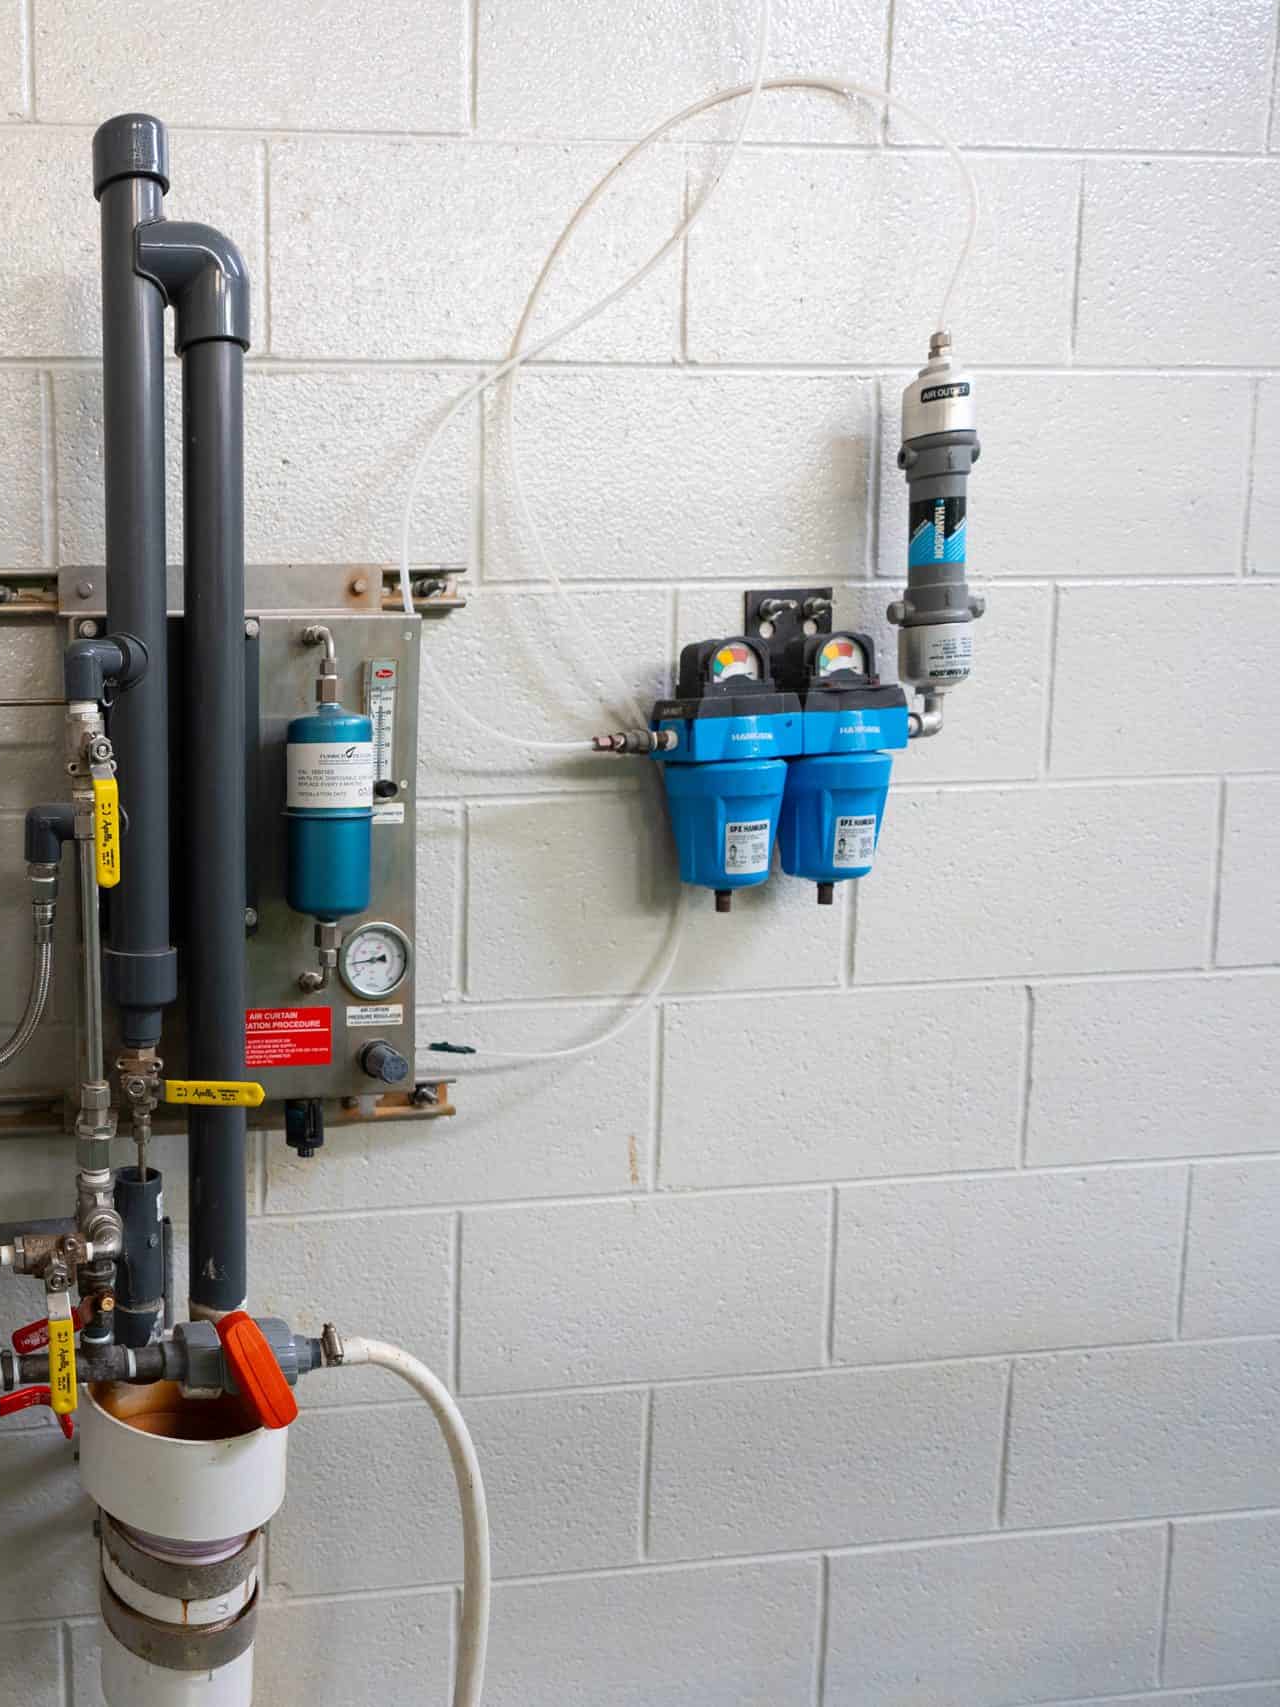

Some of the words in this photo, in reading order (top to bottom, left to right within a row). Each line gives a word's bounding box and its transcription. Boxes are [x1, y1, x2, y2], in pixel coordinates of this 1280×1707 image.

[937, 385, 966, 398] OUTET
[264, 1012, 298, 1020] CURTAIN
[272, 1020, 320, 1028] PROCEDURE
